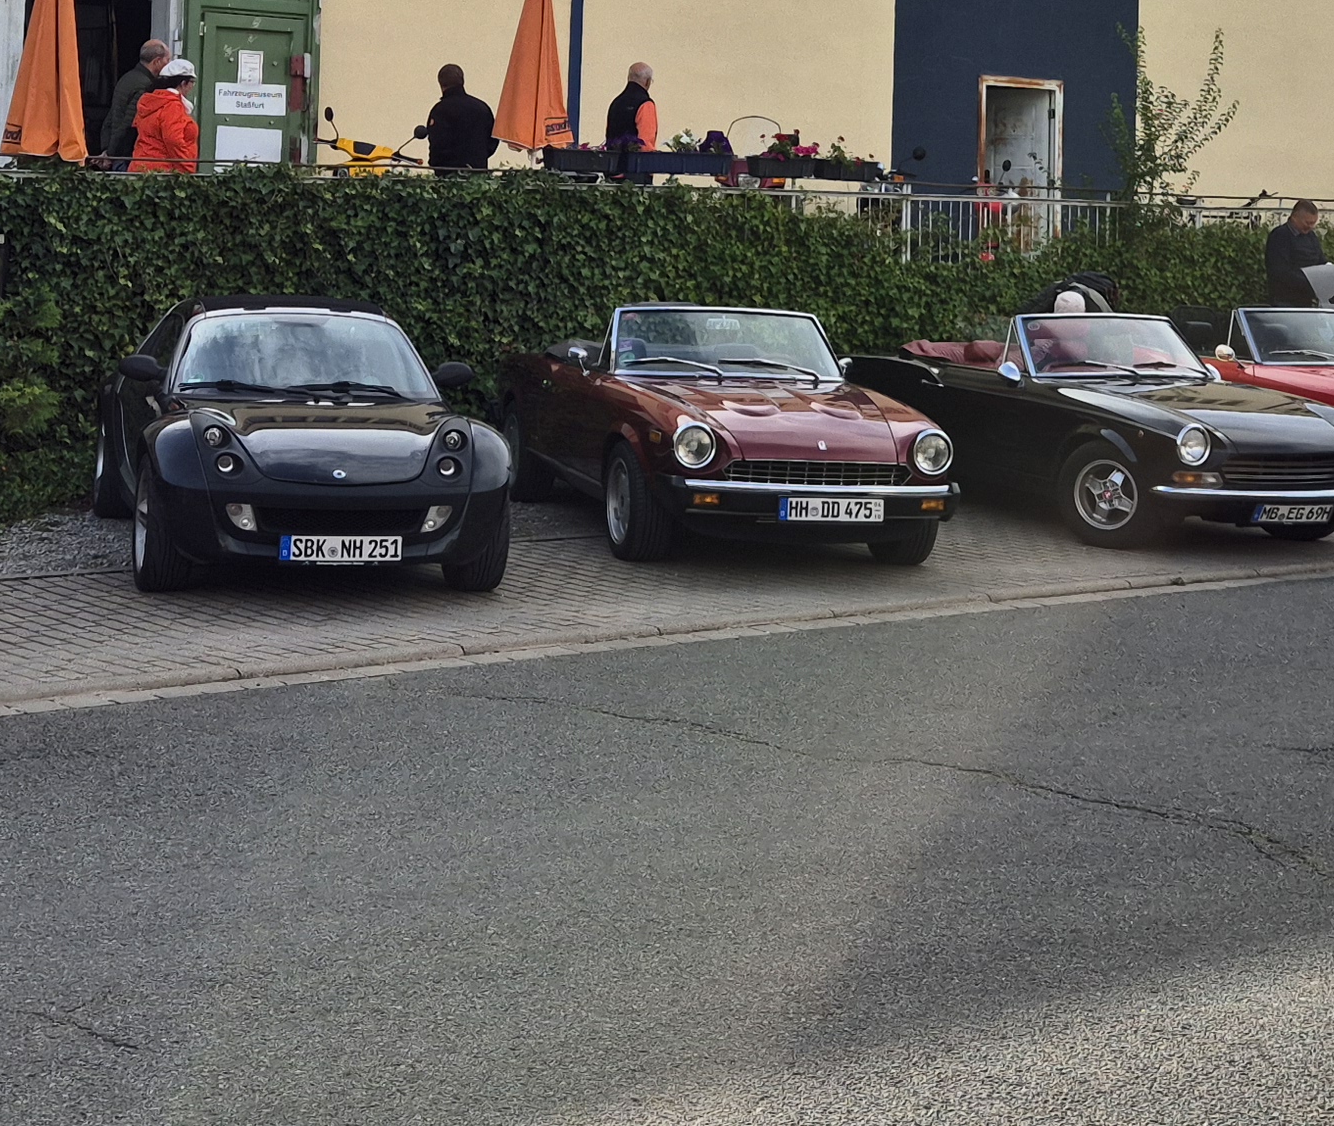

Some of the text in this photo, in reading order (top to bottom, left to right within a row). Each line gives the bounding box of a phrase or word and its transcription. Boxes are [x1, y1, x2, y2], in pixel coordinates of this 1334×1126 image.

[218, 89, 283, 99] Fahrzeugmuseum
[235, 100, 265, 109] Staßfurt
[789, 501, 809, 518] HH
[821, 501, 840, 518] DD
[845, 501, 873, 519] 475
[1260, 507, 1333, 520] MB EG 69H
[292, 538, 326, 558] SBK
[341, 539, 363, 558] NH
[368, 539, 399, 558] 251
